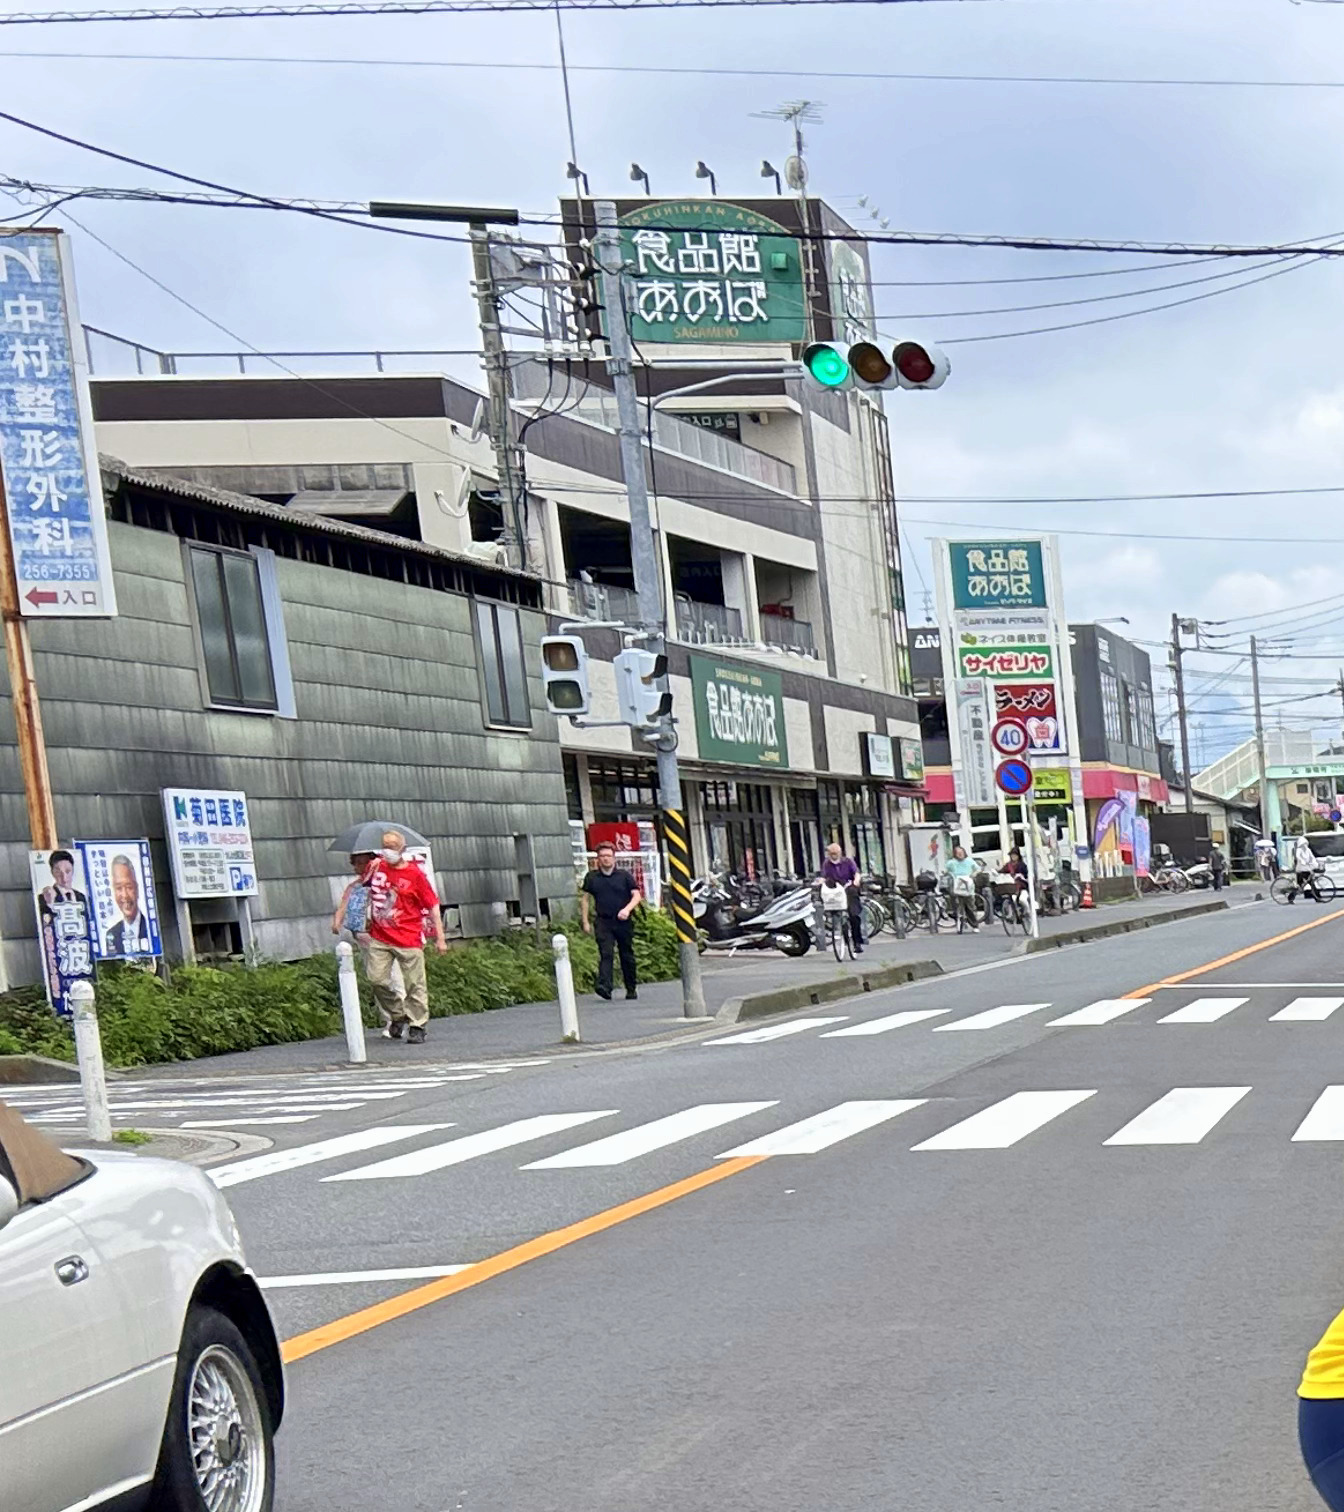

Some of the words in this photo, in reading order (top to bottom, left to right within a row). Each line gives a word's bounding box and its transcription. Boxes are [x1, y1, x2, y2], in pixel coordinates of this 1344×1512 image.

[632, 227, 763, 276] 食品館
[638, 280, 769, 323] あおば
[4, 293, 75, 557] 中村整形外科
[23, 564, 91, 579] 256-7355
[967, 574, 1032, 596] あおば
[63, 589, 97, 606] 入口
[965, 652, 1047, 673] サイゼリヤ
[1000, 729, 1021, 747] 40
